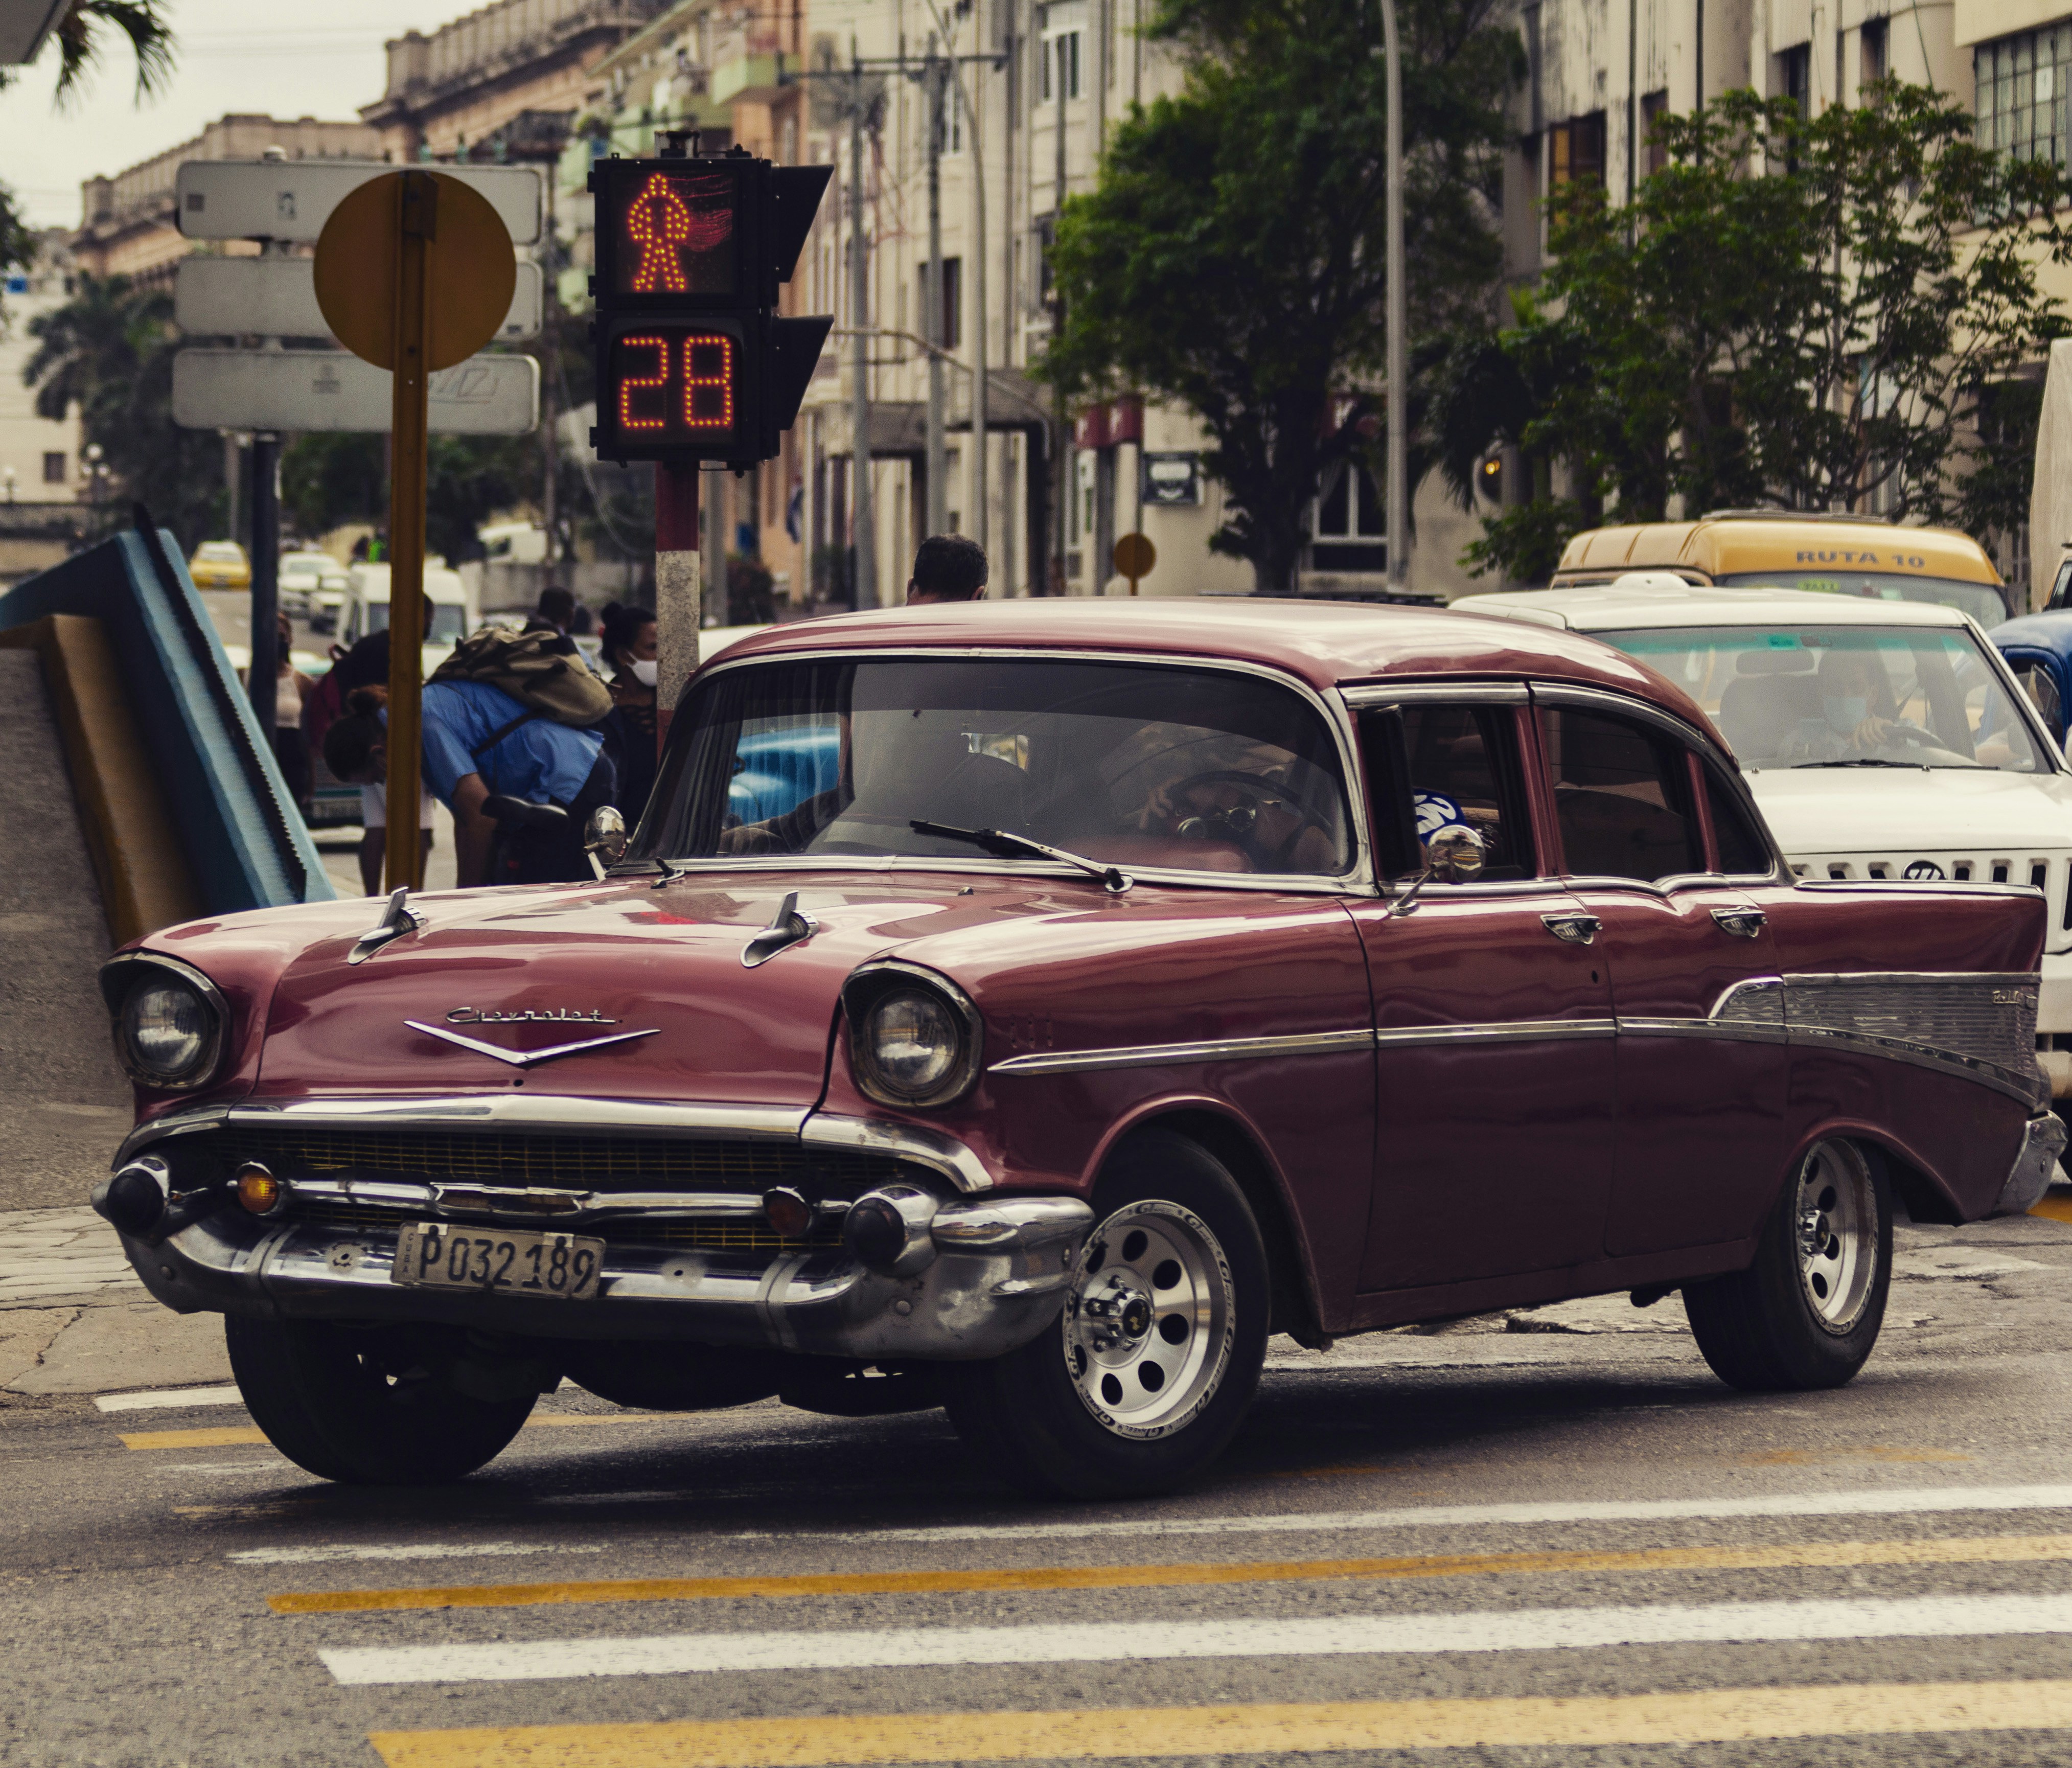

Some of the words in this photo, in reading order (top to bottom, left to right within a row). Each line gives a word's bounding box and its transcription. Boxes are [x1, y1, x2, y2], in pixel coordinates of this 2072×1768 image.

[620, 336, 733, 428] 28
[1797, 550, 1879, 563] RUTA
[1892, 554, 1925, 568] 10
[446, 1006, 616, 1024] Chevrolet
[402, 1232, 415, 1273] CUBA
